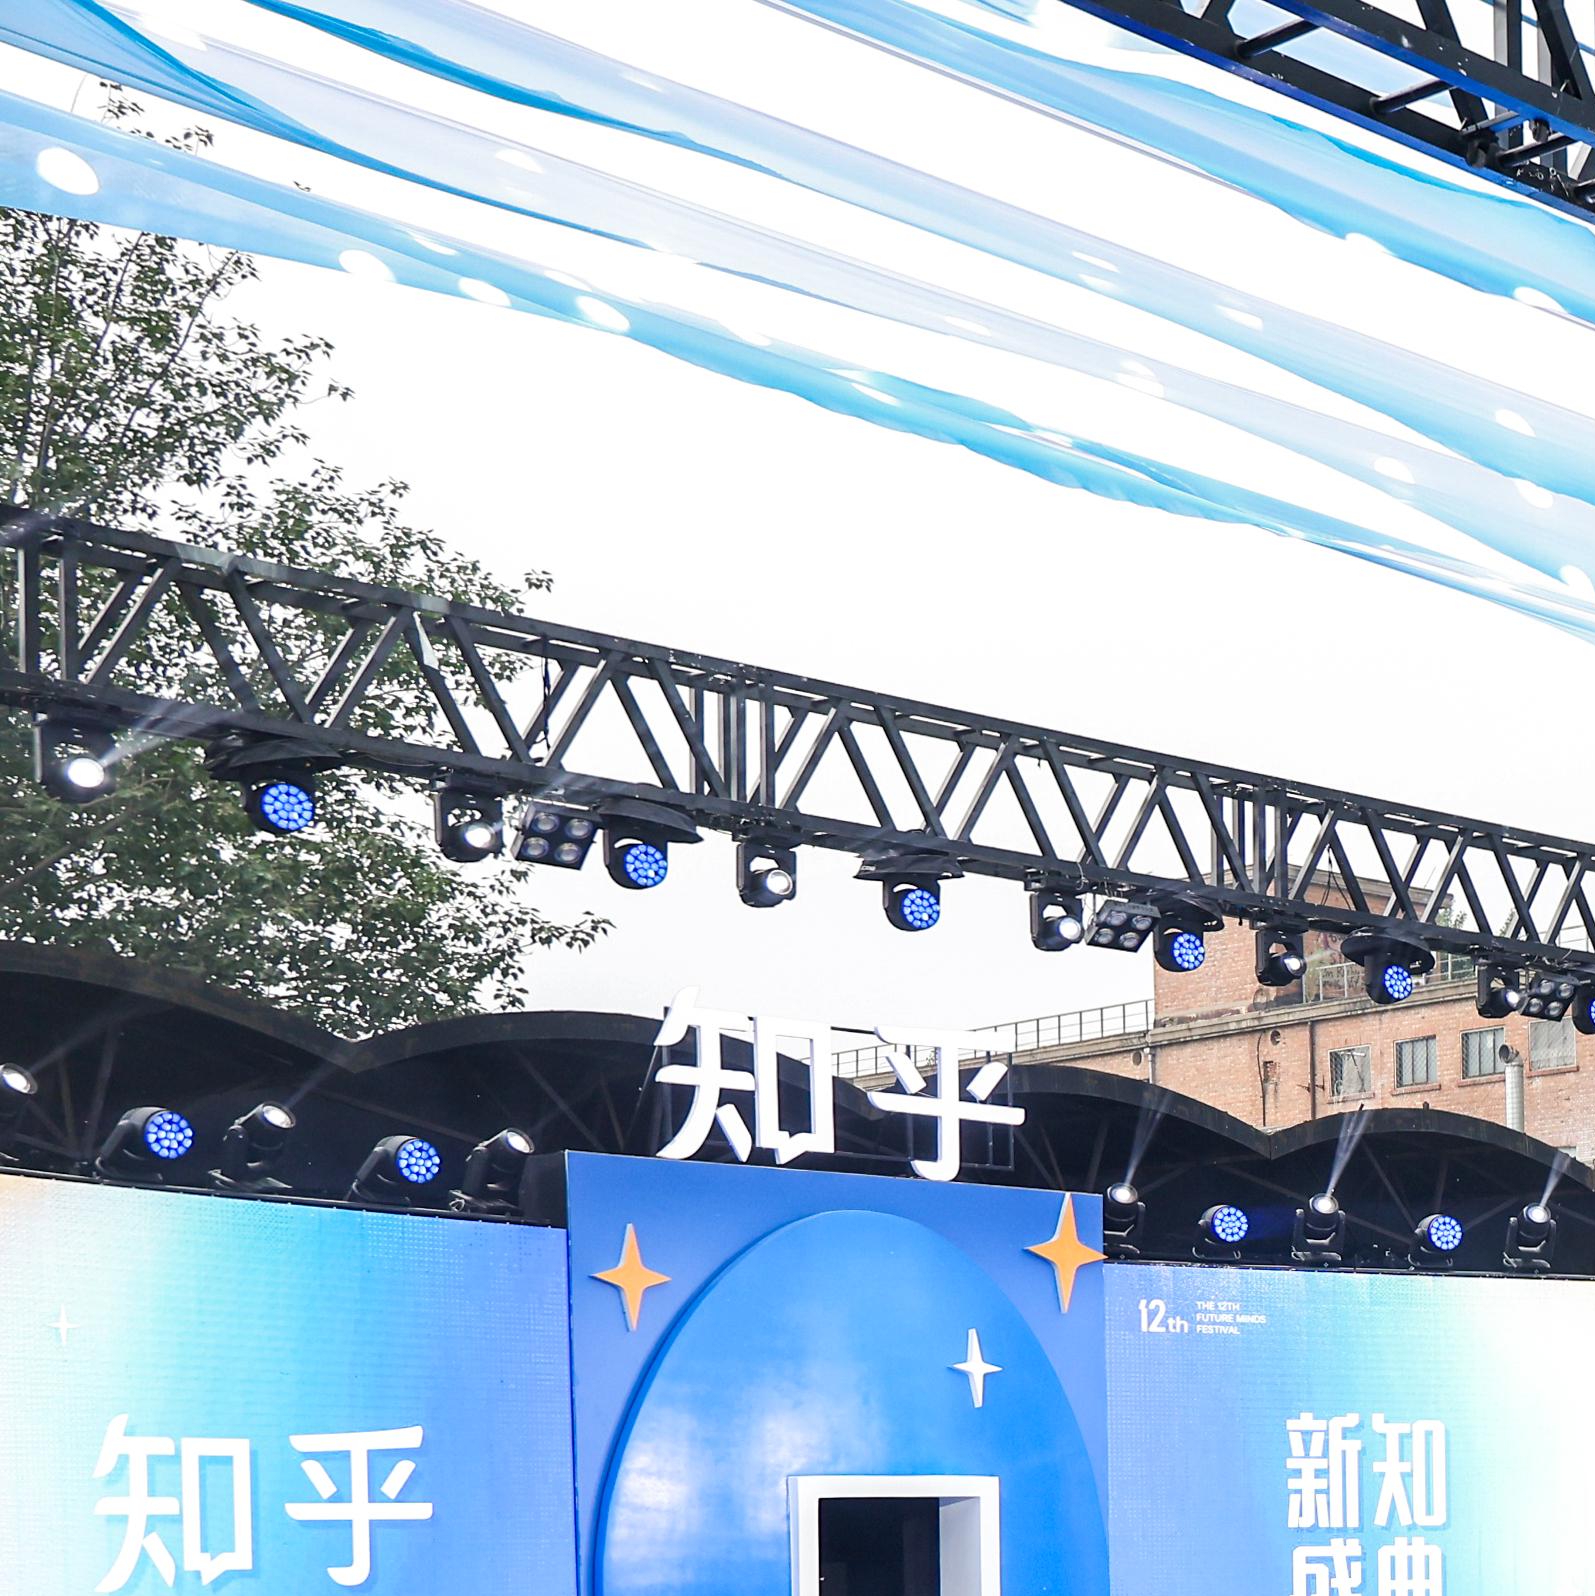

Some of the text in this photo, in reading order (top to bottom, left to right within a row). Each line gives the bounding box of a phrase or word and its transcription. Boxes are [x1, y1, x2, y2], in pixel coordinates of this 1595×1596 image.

[653, 985, 1026, 1182] 知乎
[1138, 1299, 1189, 1333] 12th
[1196, 1301, 1240, 1311] THE 12TH
[1196, 1313, 1267, 1324] FUTURE MINDS
[1196, 1325, 1241, 1335] FESTIVAL
[1285, 1412, 1448, 1528] 新知
[92, 1413, 434, 1594] 知乎
